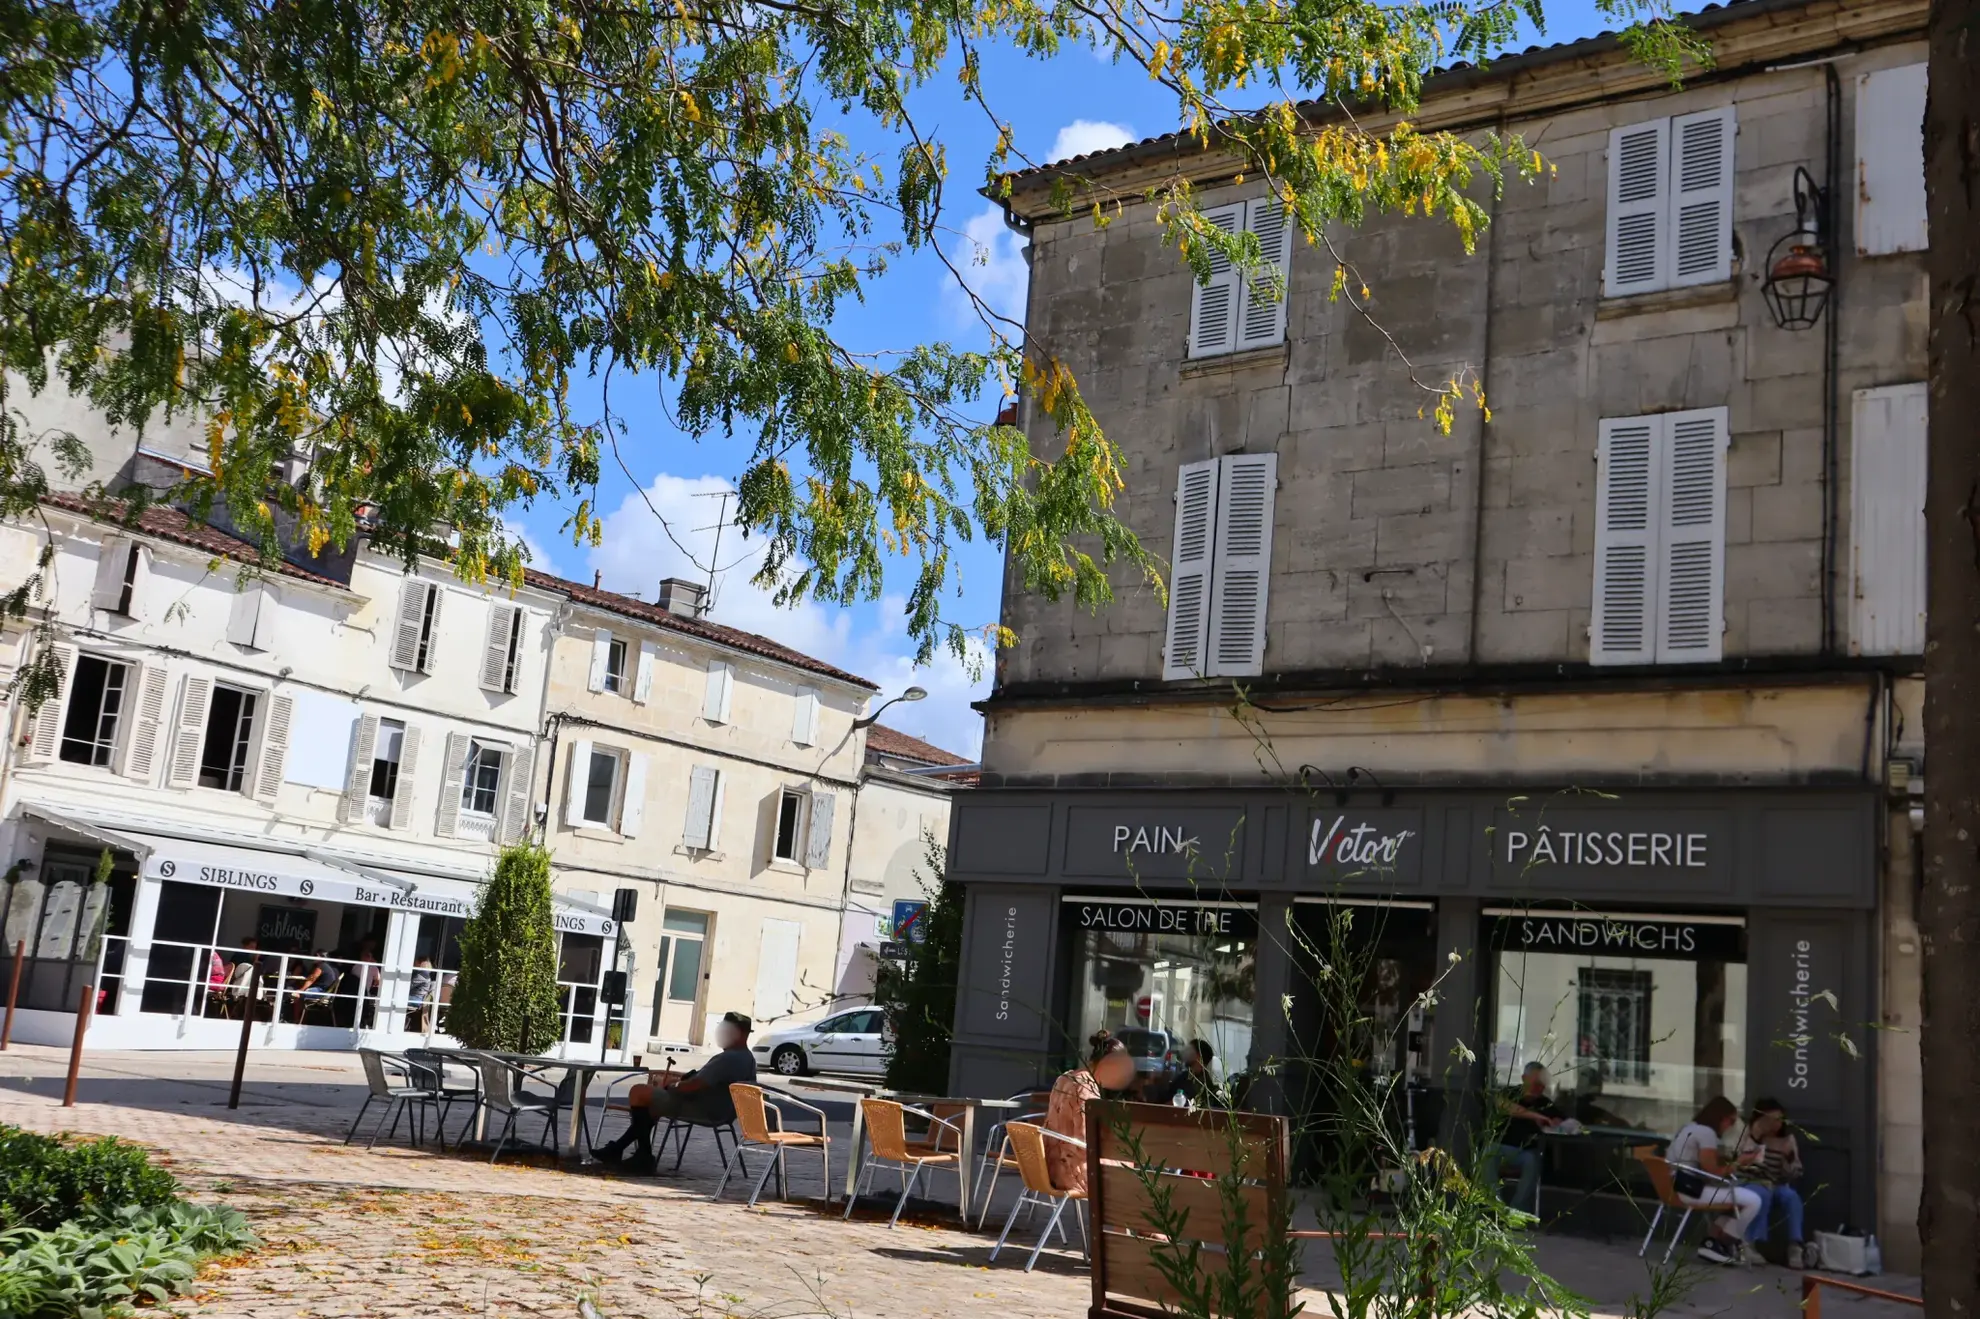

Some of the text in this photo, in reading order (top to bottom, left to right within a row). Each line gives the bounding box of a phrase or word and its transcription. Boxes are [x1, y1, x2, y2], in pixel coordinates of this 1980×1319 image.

[1113, 825, 1182, 853] PAIN
[1309, 815, 1398, 865] Victor
[1508, 825, 1707, 867] PÂTISSERIE
[200, 867, 278, 890] SIBLINGS
[355, 887, 380, 902] Bar
[390, 891, 462, 914] Restaurant
[1081, 906, 1151, 928] SALON
[1159, 909, 1187, 931] DE
[1521, 920, 1696, 951] SANDWICHS
[996, 907, 1017, 1020] Sandwicherie
[1788, 940, 1810, 1088] Sandwicherie
